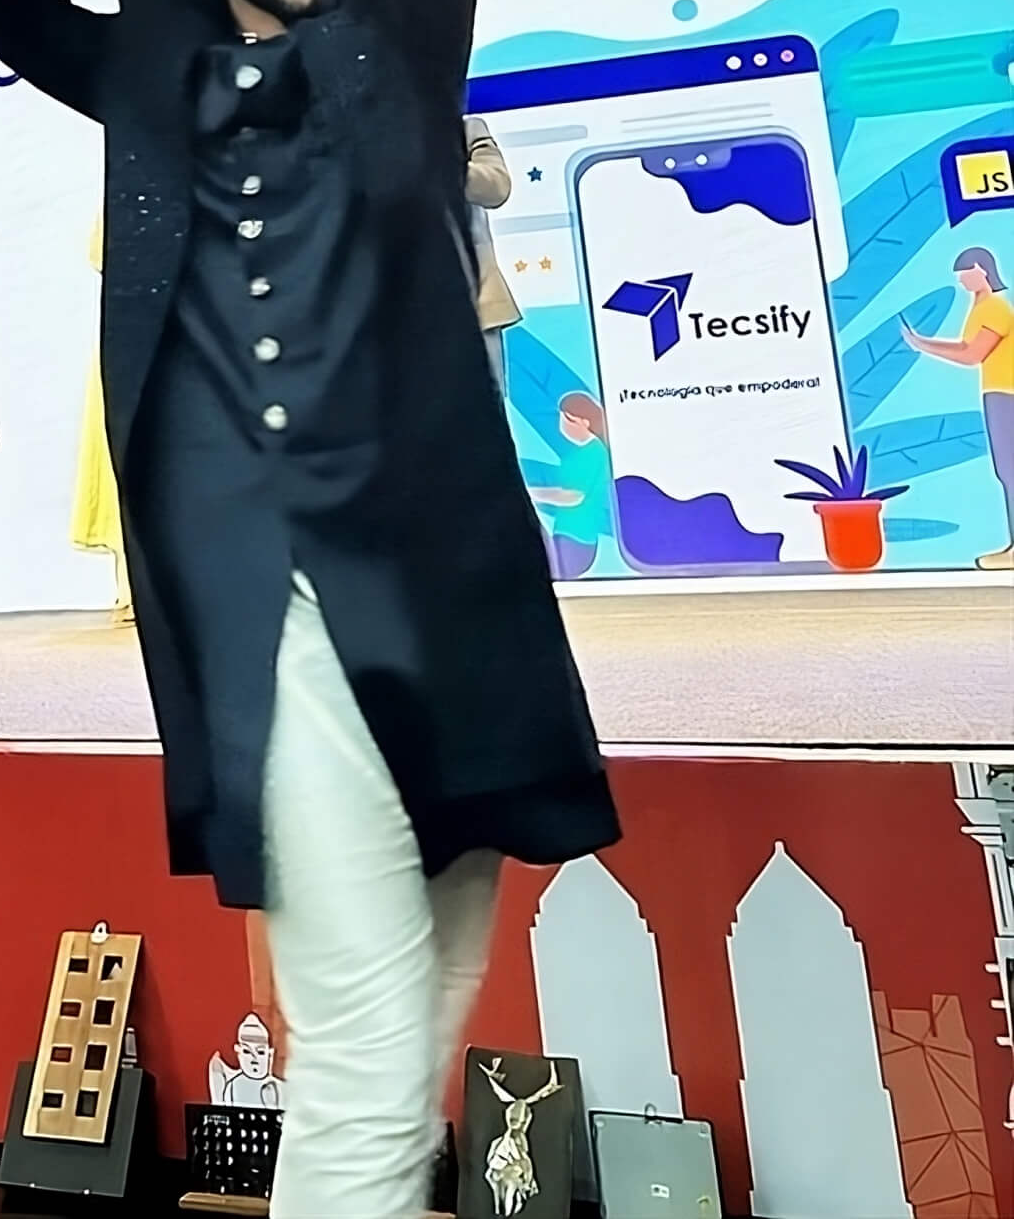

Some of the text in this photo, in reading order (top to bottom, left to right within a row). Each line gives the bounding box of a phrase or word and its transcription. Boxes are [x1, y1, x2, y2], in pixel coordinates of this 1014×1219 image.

[976, 172, 1009, 194] JS
[688, 304, 811, 339] Tecsify
[705, 384, 733, 397] que
